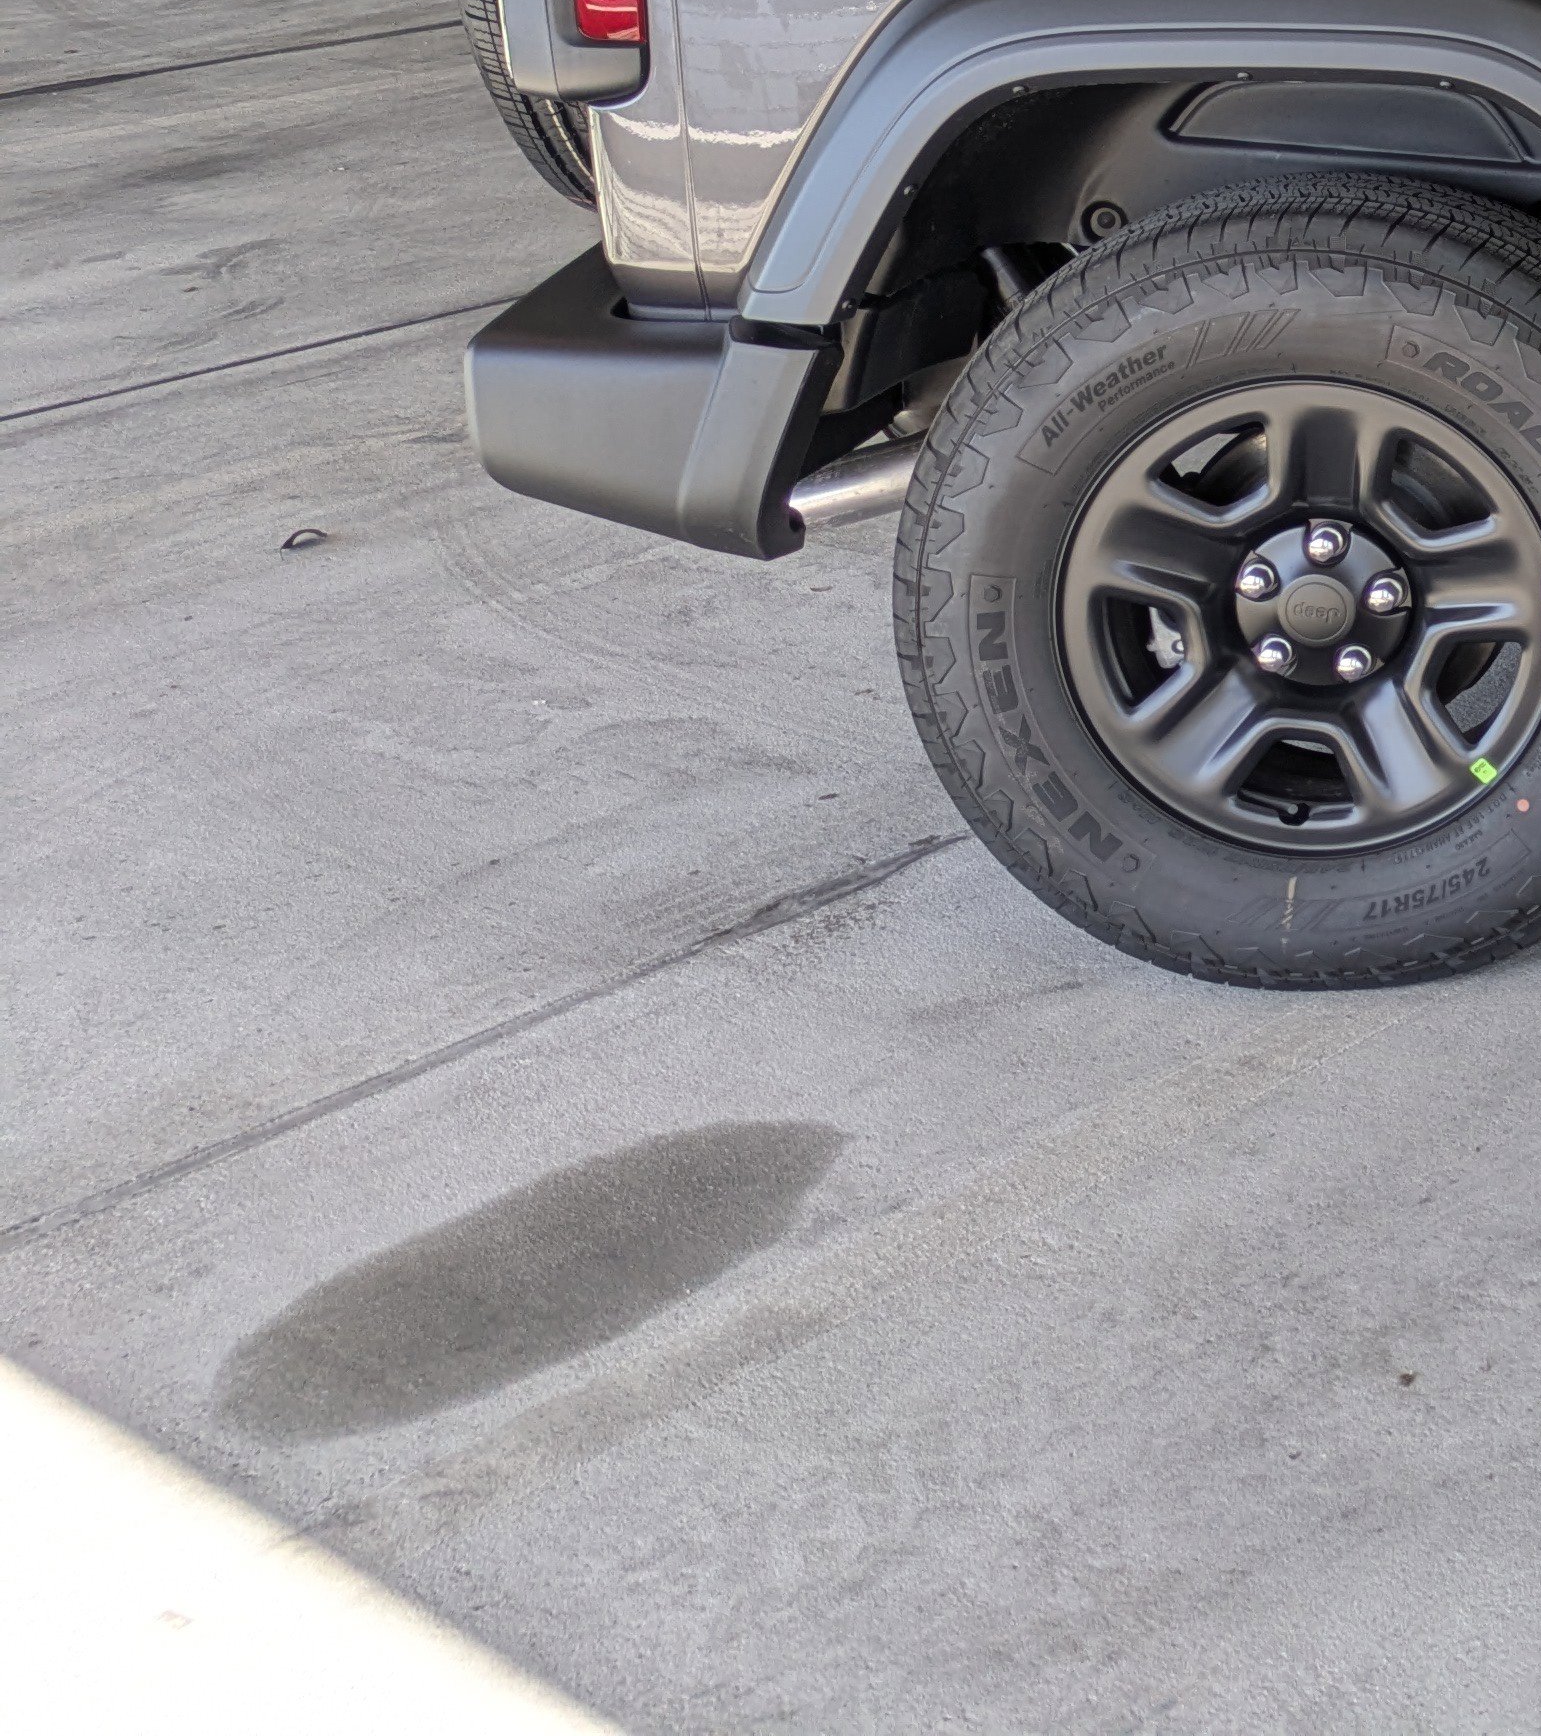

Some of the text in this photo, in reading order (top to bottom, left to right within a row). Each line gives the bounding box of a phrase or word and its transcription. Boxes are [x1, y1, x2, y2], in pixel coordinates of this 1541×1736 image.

[1040, 342, 1168, 448] All-Weather
[1096, 359, 1176, 414] Performance
[1293, 602, 1340, 623] Jeep
[975, 610, 1124, 864] NEXEN
[1363, 856, 1490, 921] 245/75R17
